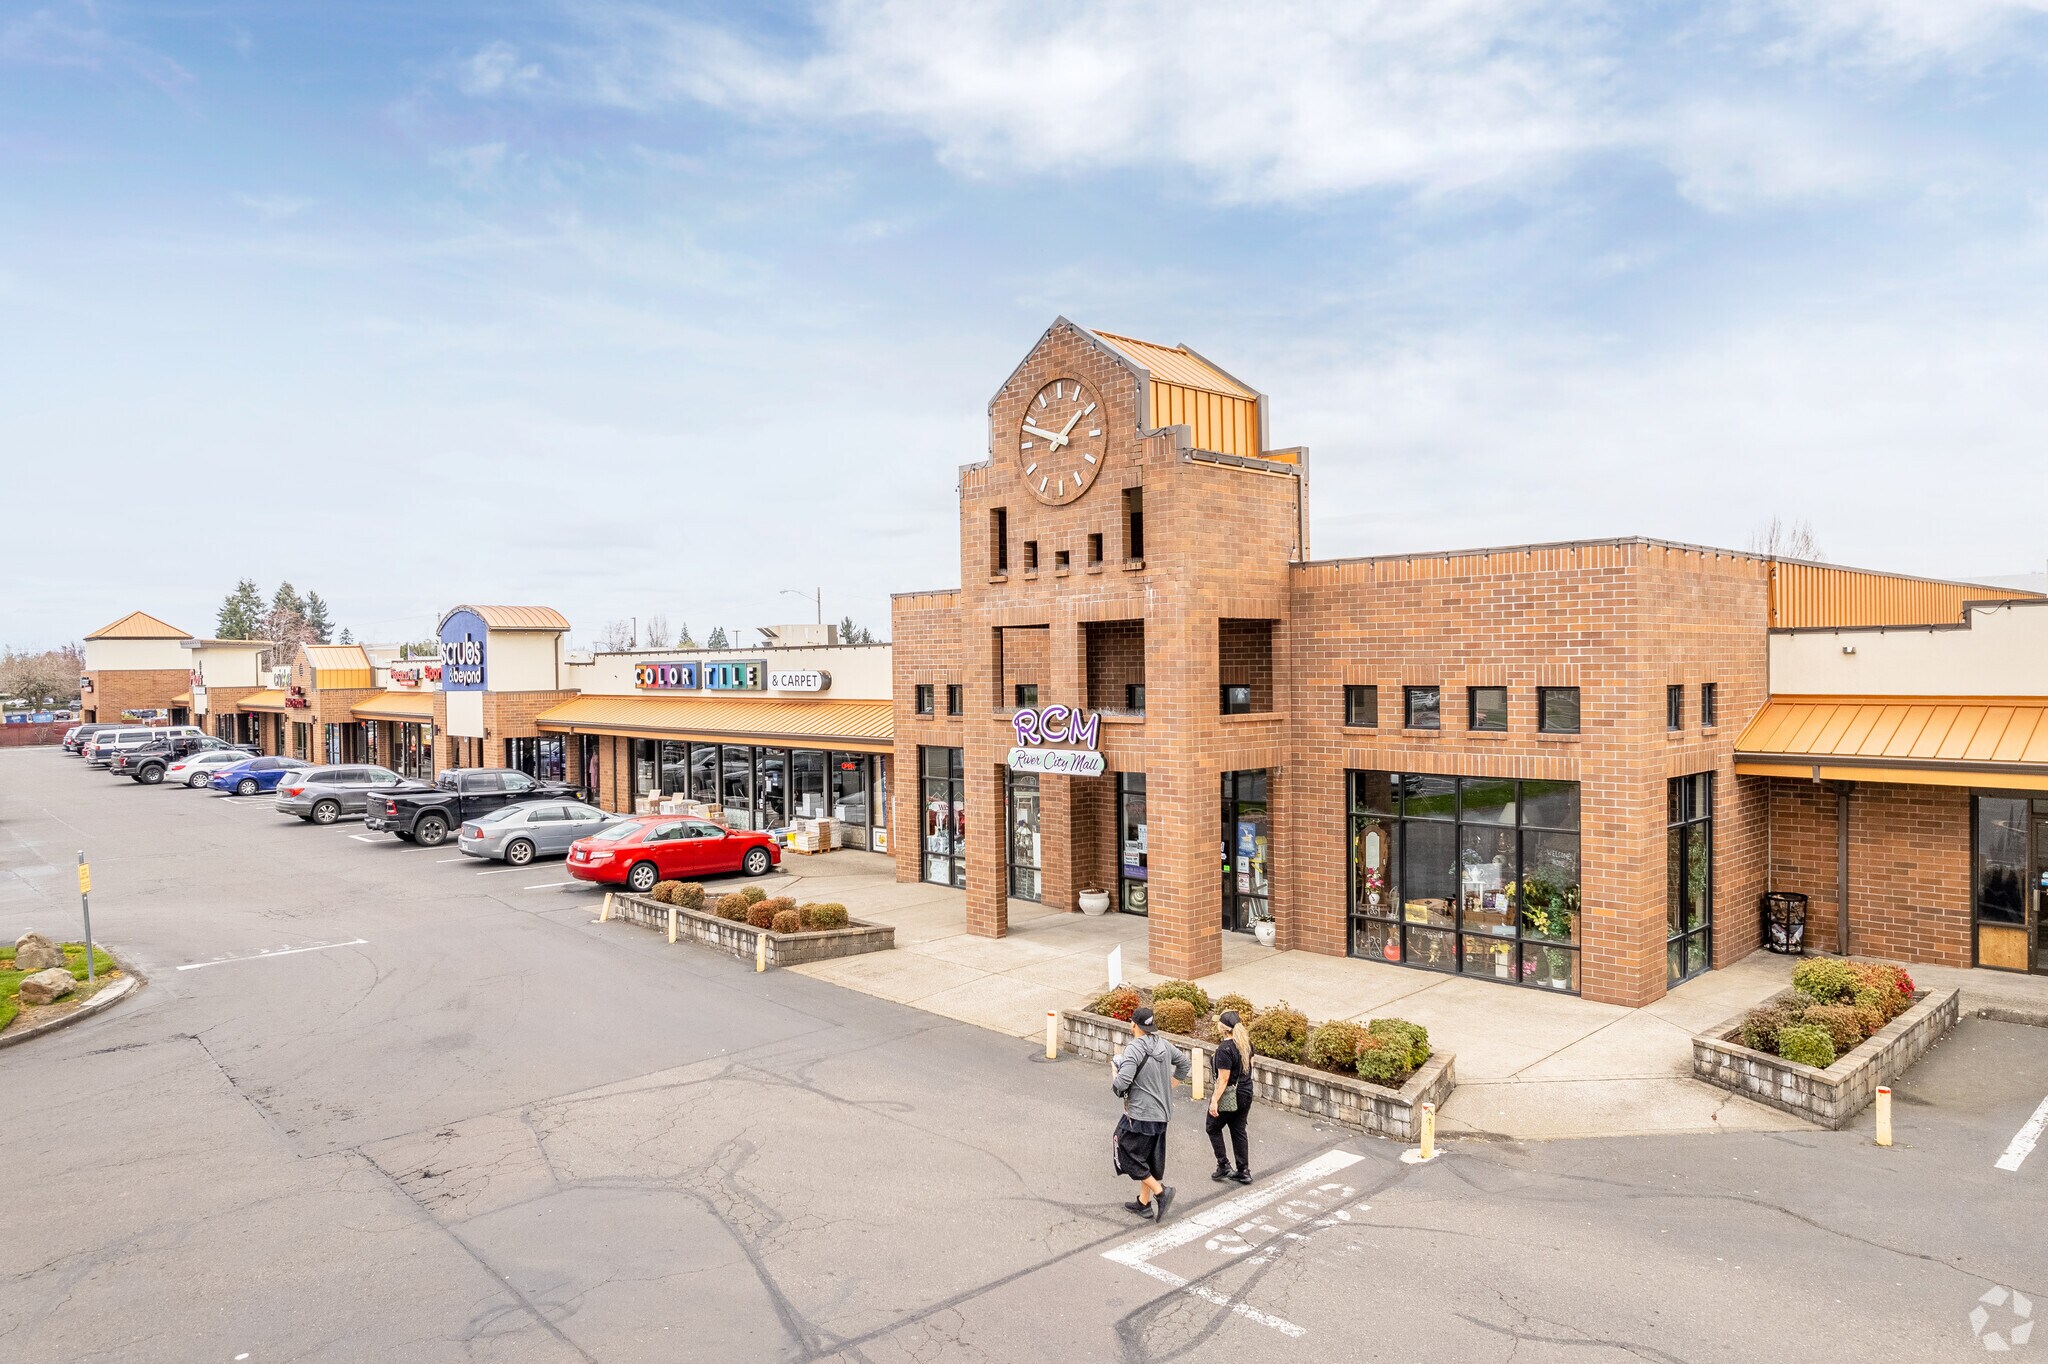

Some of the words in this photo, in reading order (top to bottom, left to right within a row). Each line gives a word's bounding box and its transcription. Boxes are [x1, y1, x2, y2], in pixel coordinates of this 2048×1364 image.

[441, 633, 481, 666] scrubs
[635, 667, 690, 685] COLOR
[704, 667, 756, 686] TILE
[772, 675, 778, 686] &
[781, 674, 818, 687] CARPET
[1012, 704, 1099, 750] RCM
[841, 761, 856, 770] OPEN
[1013, 749, 1041, 769] River
[1044, 751, 1068, 772] City
[1070, 753, 1099, 773] Mall
